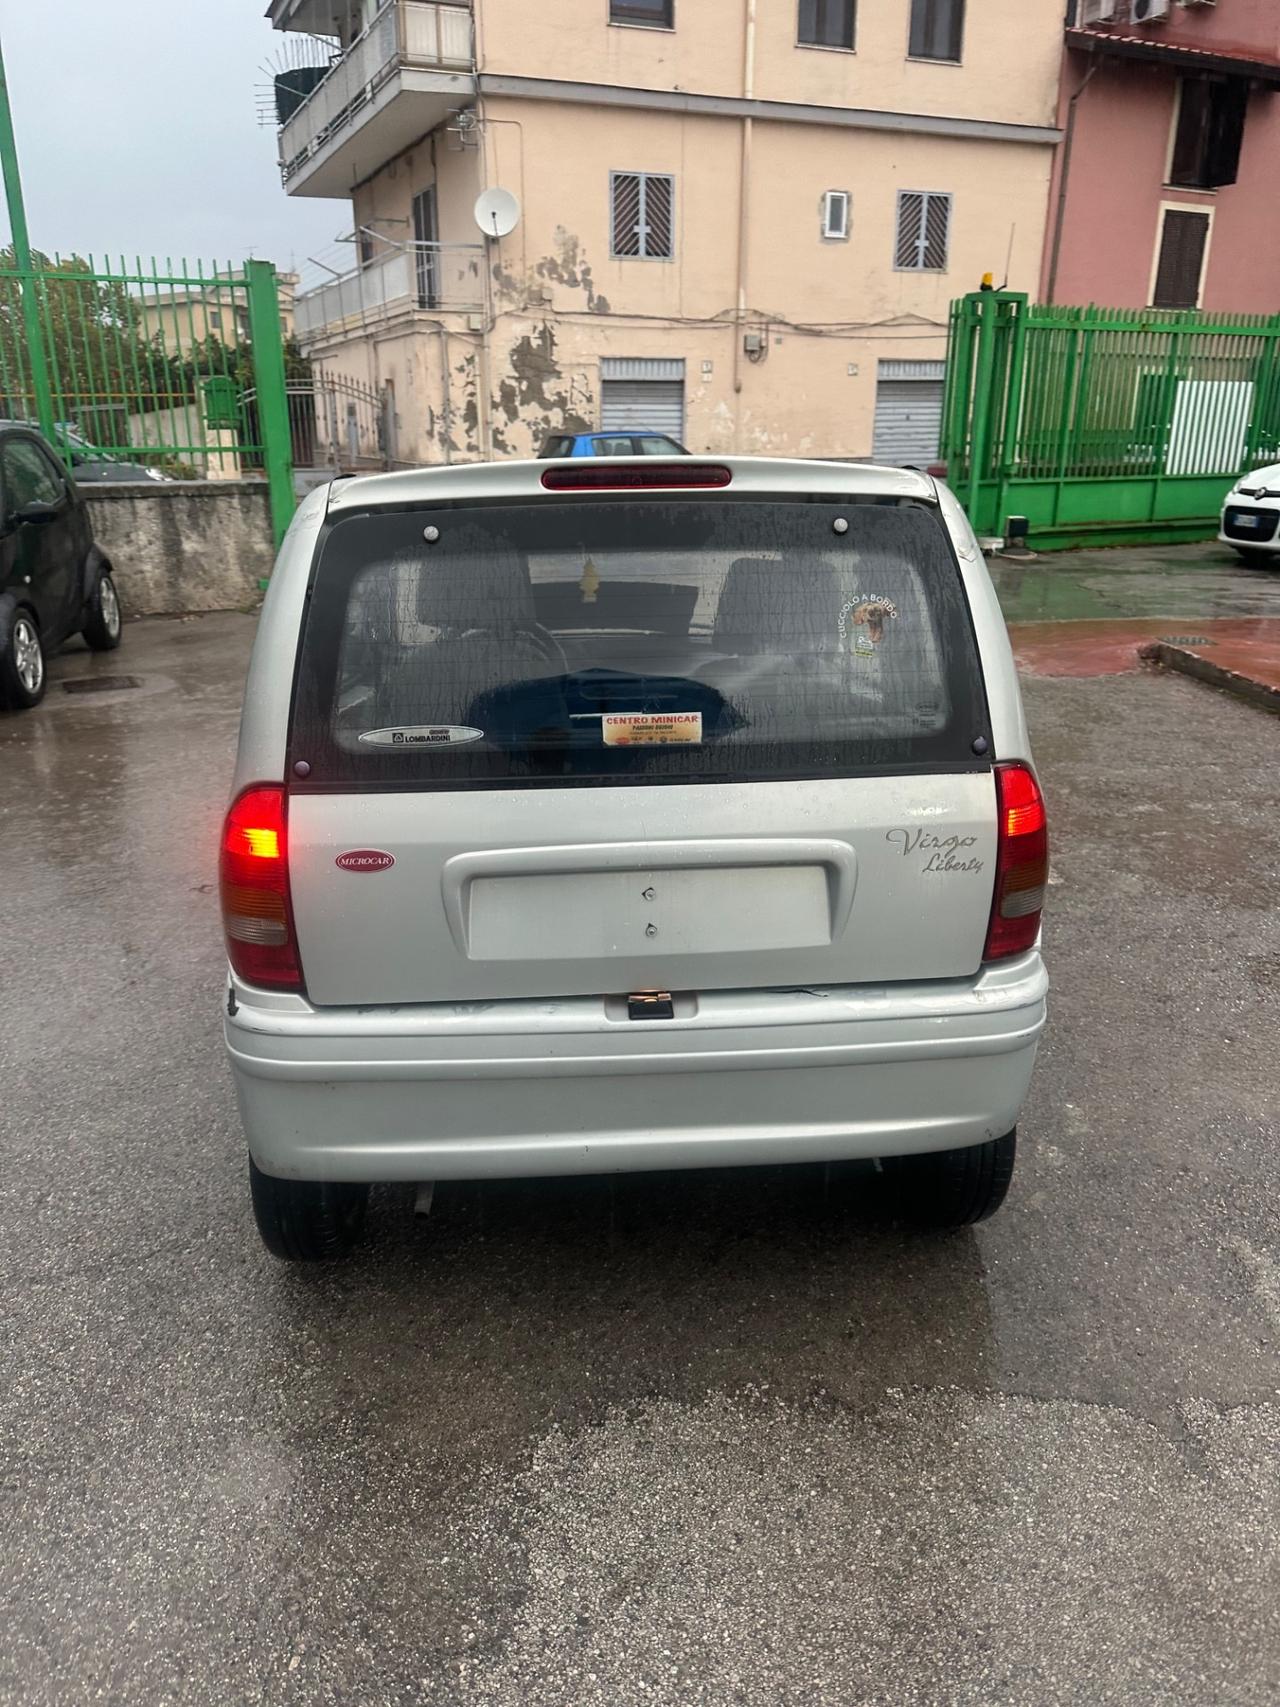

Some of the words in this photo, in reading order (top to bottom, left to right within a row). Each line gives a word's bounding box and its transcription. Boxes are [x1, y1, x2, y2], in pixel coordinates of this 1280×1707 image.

[838, 596, 860, 639] CUCCIOLO
[870, 594, 897, 619] BORDO
[606, 716, 648, 725] CENTRO
[651, 715, 698, 724] MINICAR
[405, 735, 450, 743] LOMBARDINI
[885, 828, 978, 858] Virgo
[340, 857, 390, 865] MICROCAR
[922, 852, 984, 874] Liberty
